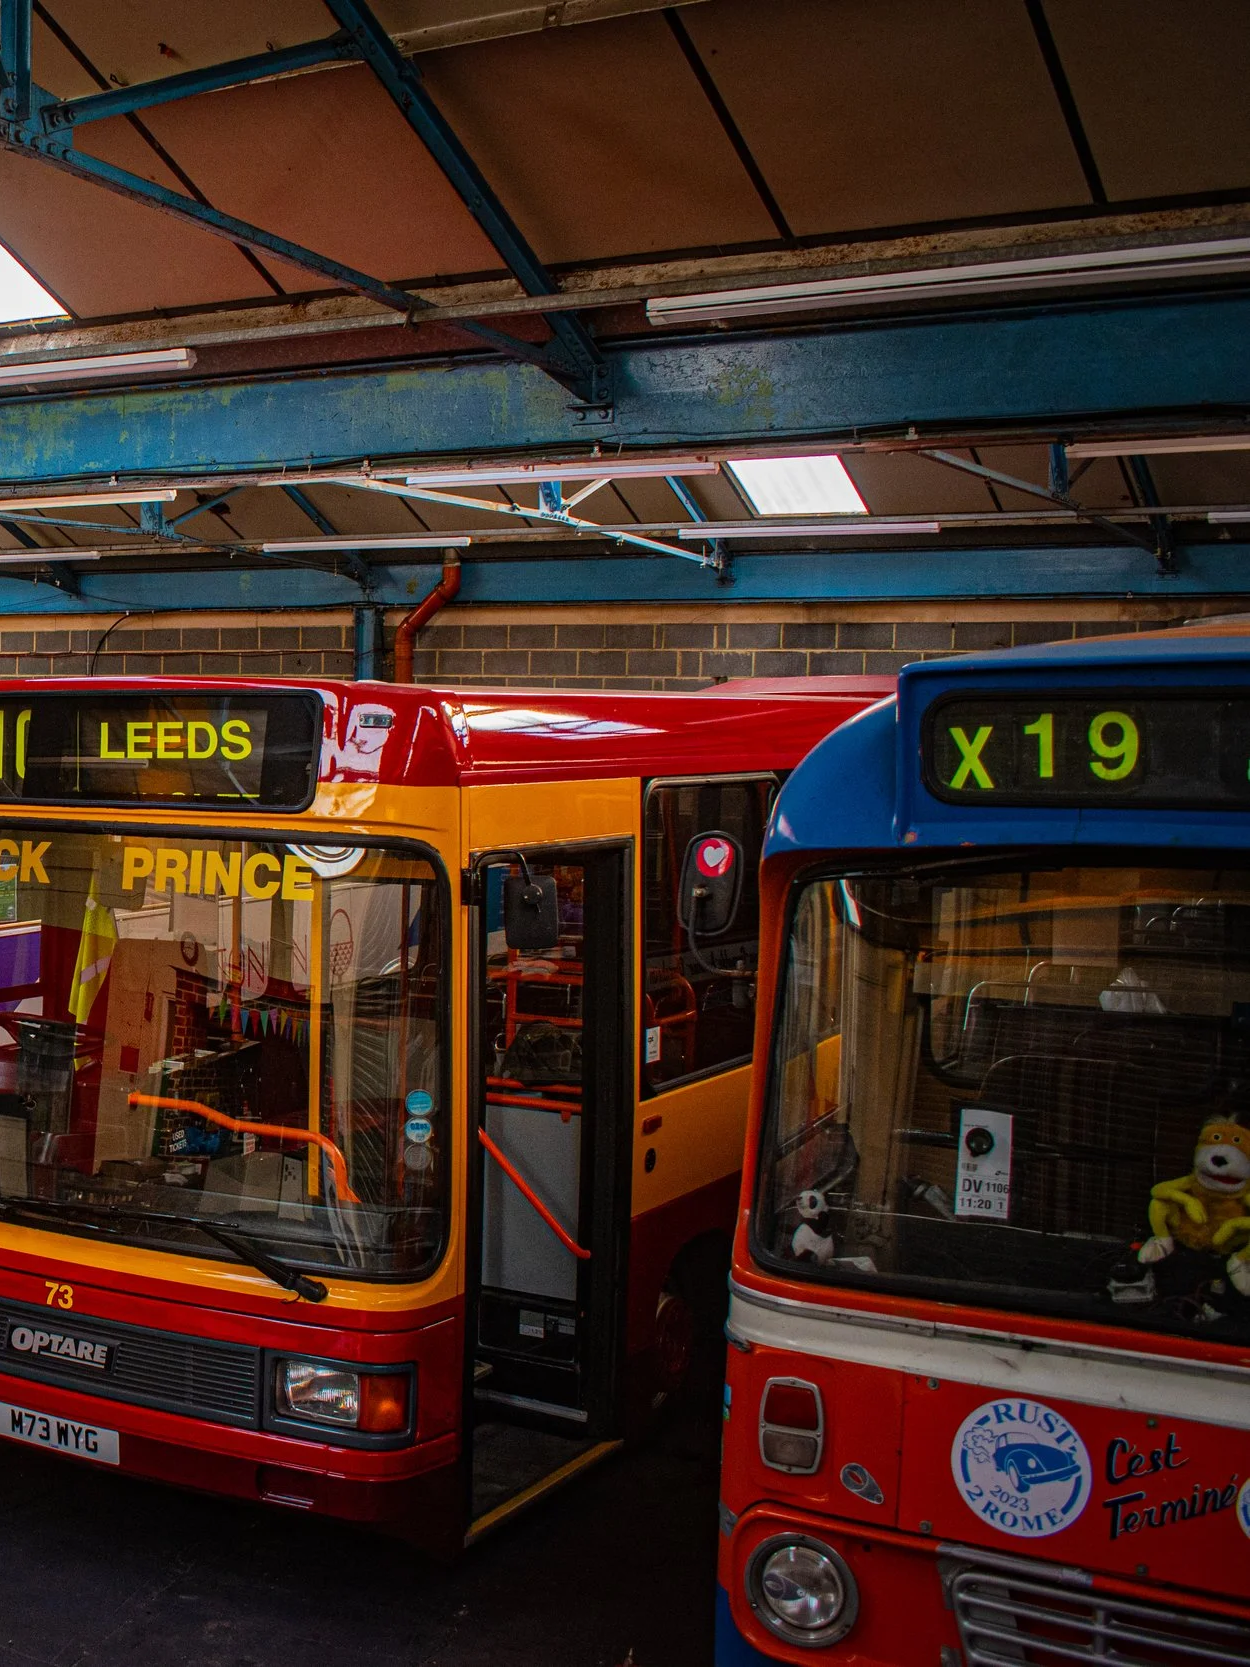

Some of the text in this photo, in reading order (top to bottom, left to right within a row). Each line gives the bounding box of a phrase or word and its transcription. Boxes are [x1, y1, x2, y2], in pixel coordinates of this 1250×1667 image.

[100, 718, 252, 760] LEEDS
[122, 846, 316, 902] PRINCE
[172, 1129, 185, 1141] USED
[960, 1197, 992, 1210] 11:20
[962, 1178, 1010, 1194] DV 1106
[44, 1281, 74, 1309] 73
[11, 1327, 108, 1364] OPTARE
[10, 1408, 98, 1453] M73 WYG
[991, 1402, 1078, 1453] RUST
[966, 1485, 1064, 1531] 2 ROME
[989, 1485, 1030, 1512] 2023
[1102, 1473, 1239, 1540] Terminé
